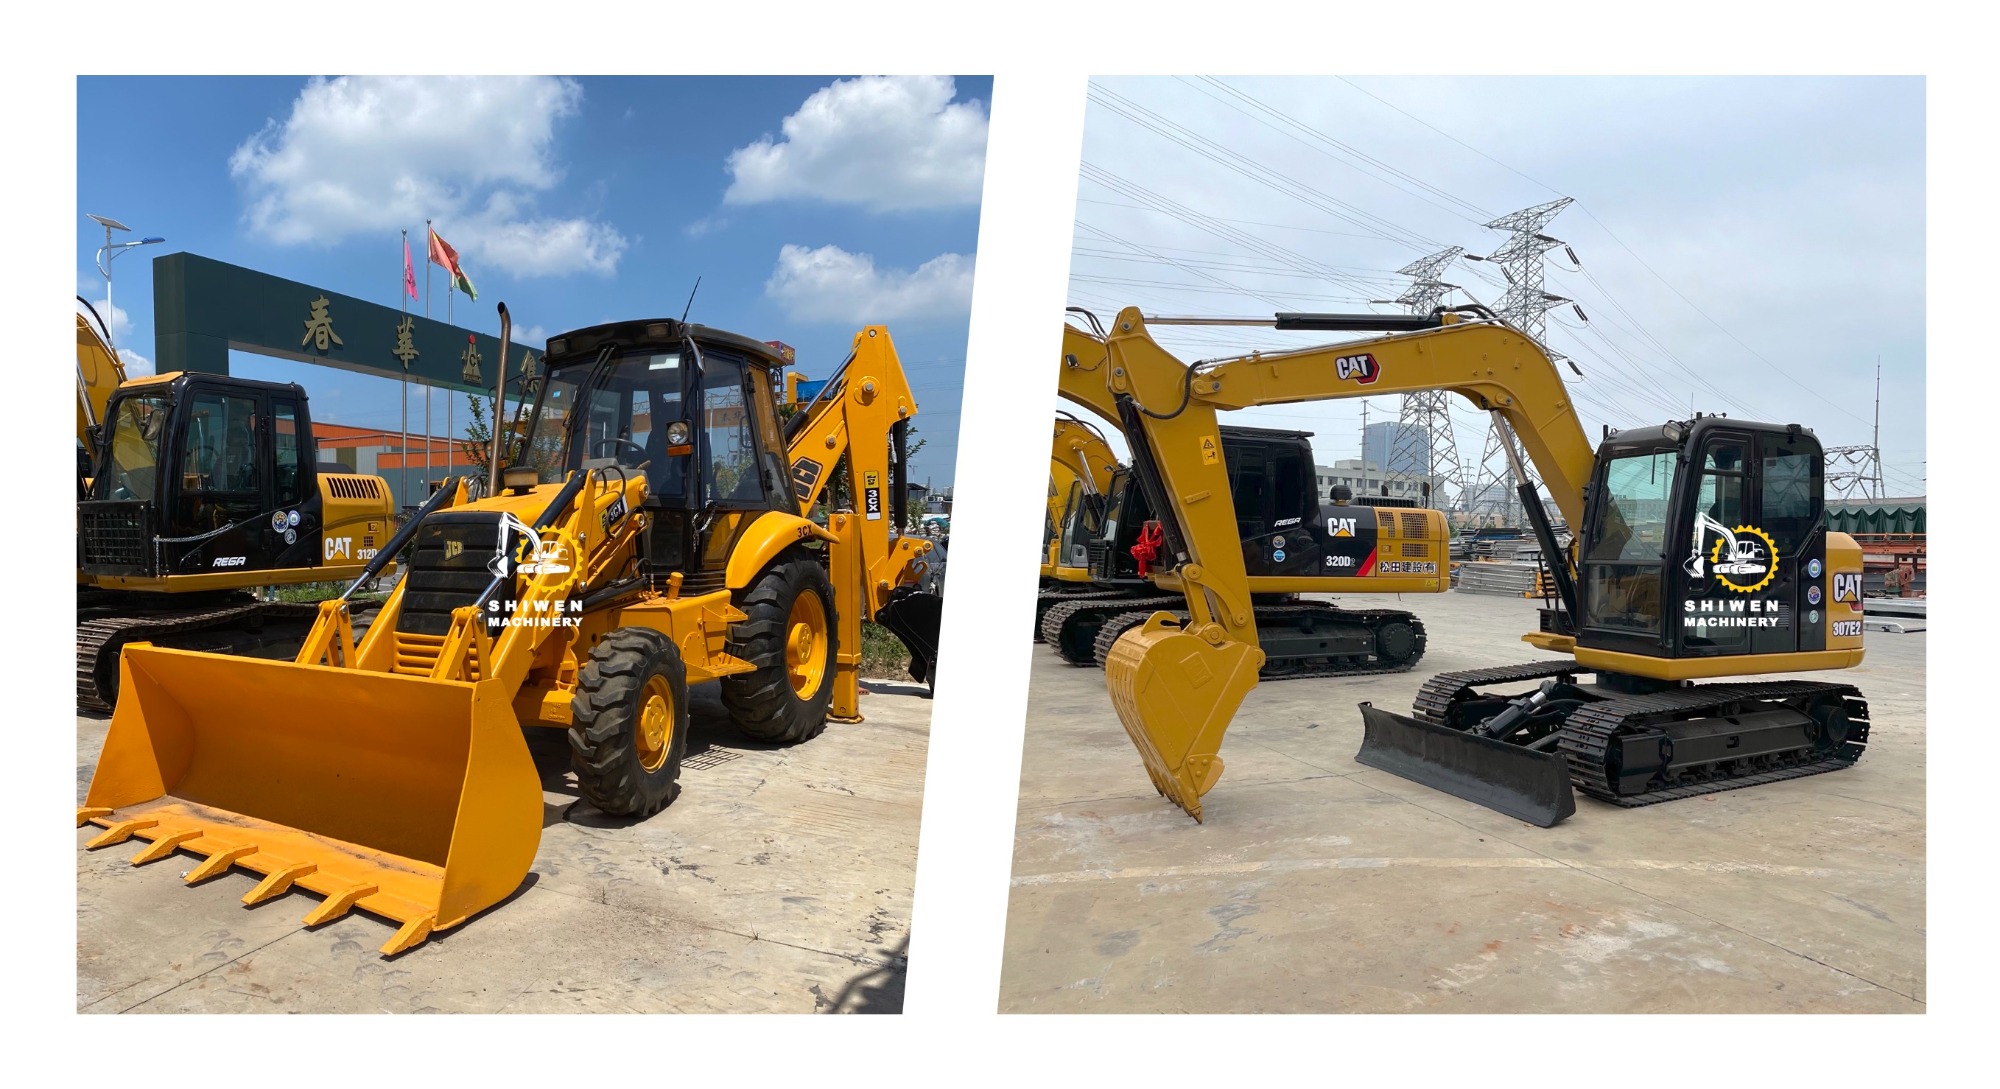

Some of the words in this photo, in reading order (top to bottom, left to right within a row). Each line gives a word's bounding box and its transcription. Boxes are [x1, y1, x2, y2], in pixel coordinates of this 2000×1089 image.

[1336, 355, 1368, 379] CAT
[867, 489, 878, 512] 3CX
[797, 524, 812, 538] 3CX
[1273, 517, 1301, 528] REGA
[1327, 517, 1357, 538] CAT
[325, 537, 352, 561] CAT
[212, 556, 247, 567] REGA
[1833, 573, 1862, 602] CAT
[1832, 620, 1861, 637] 307E2
